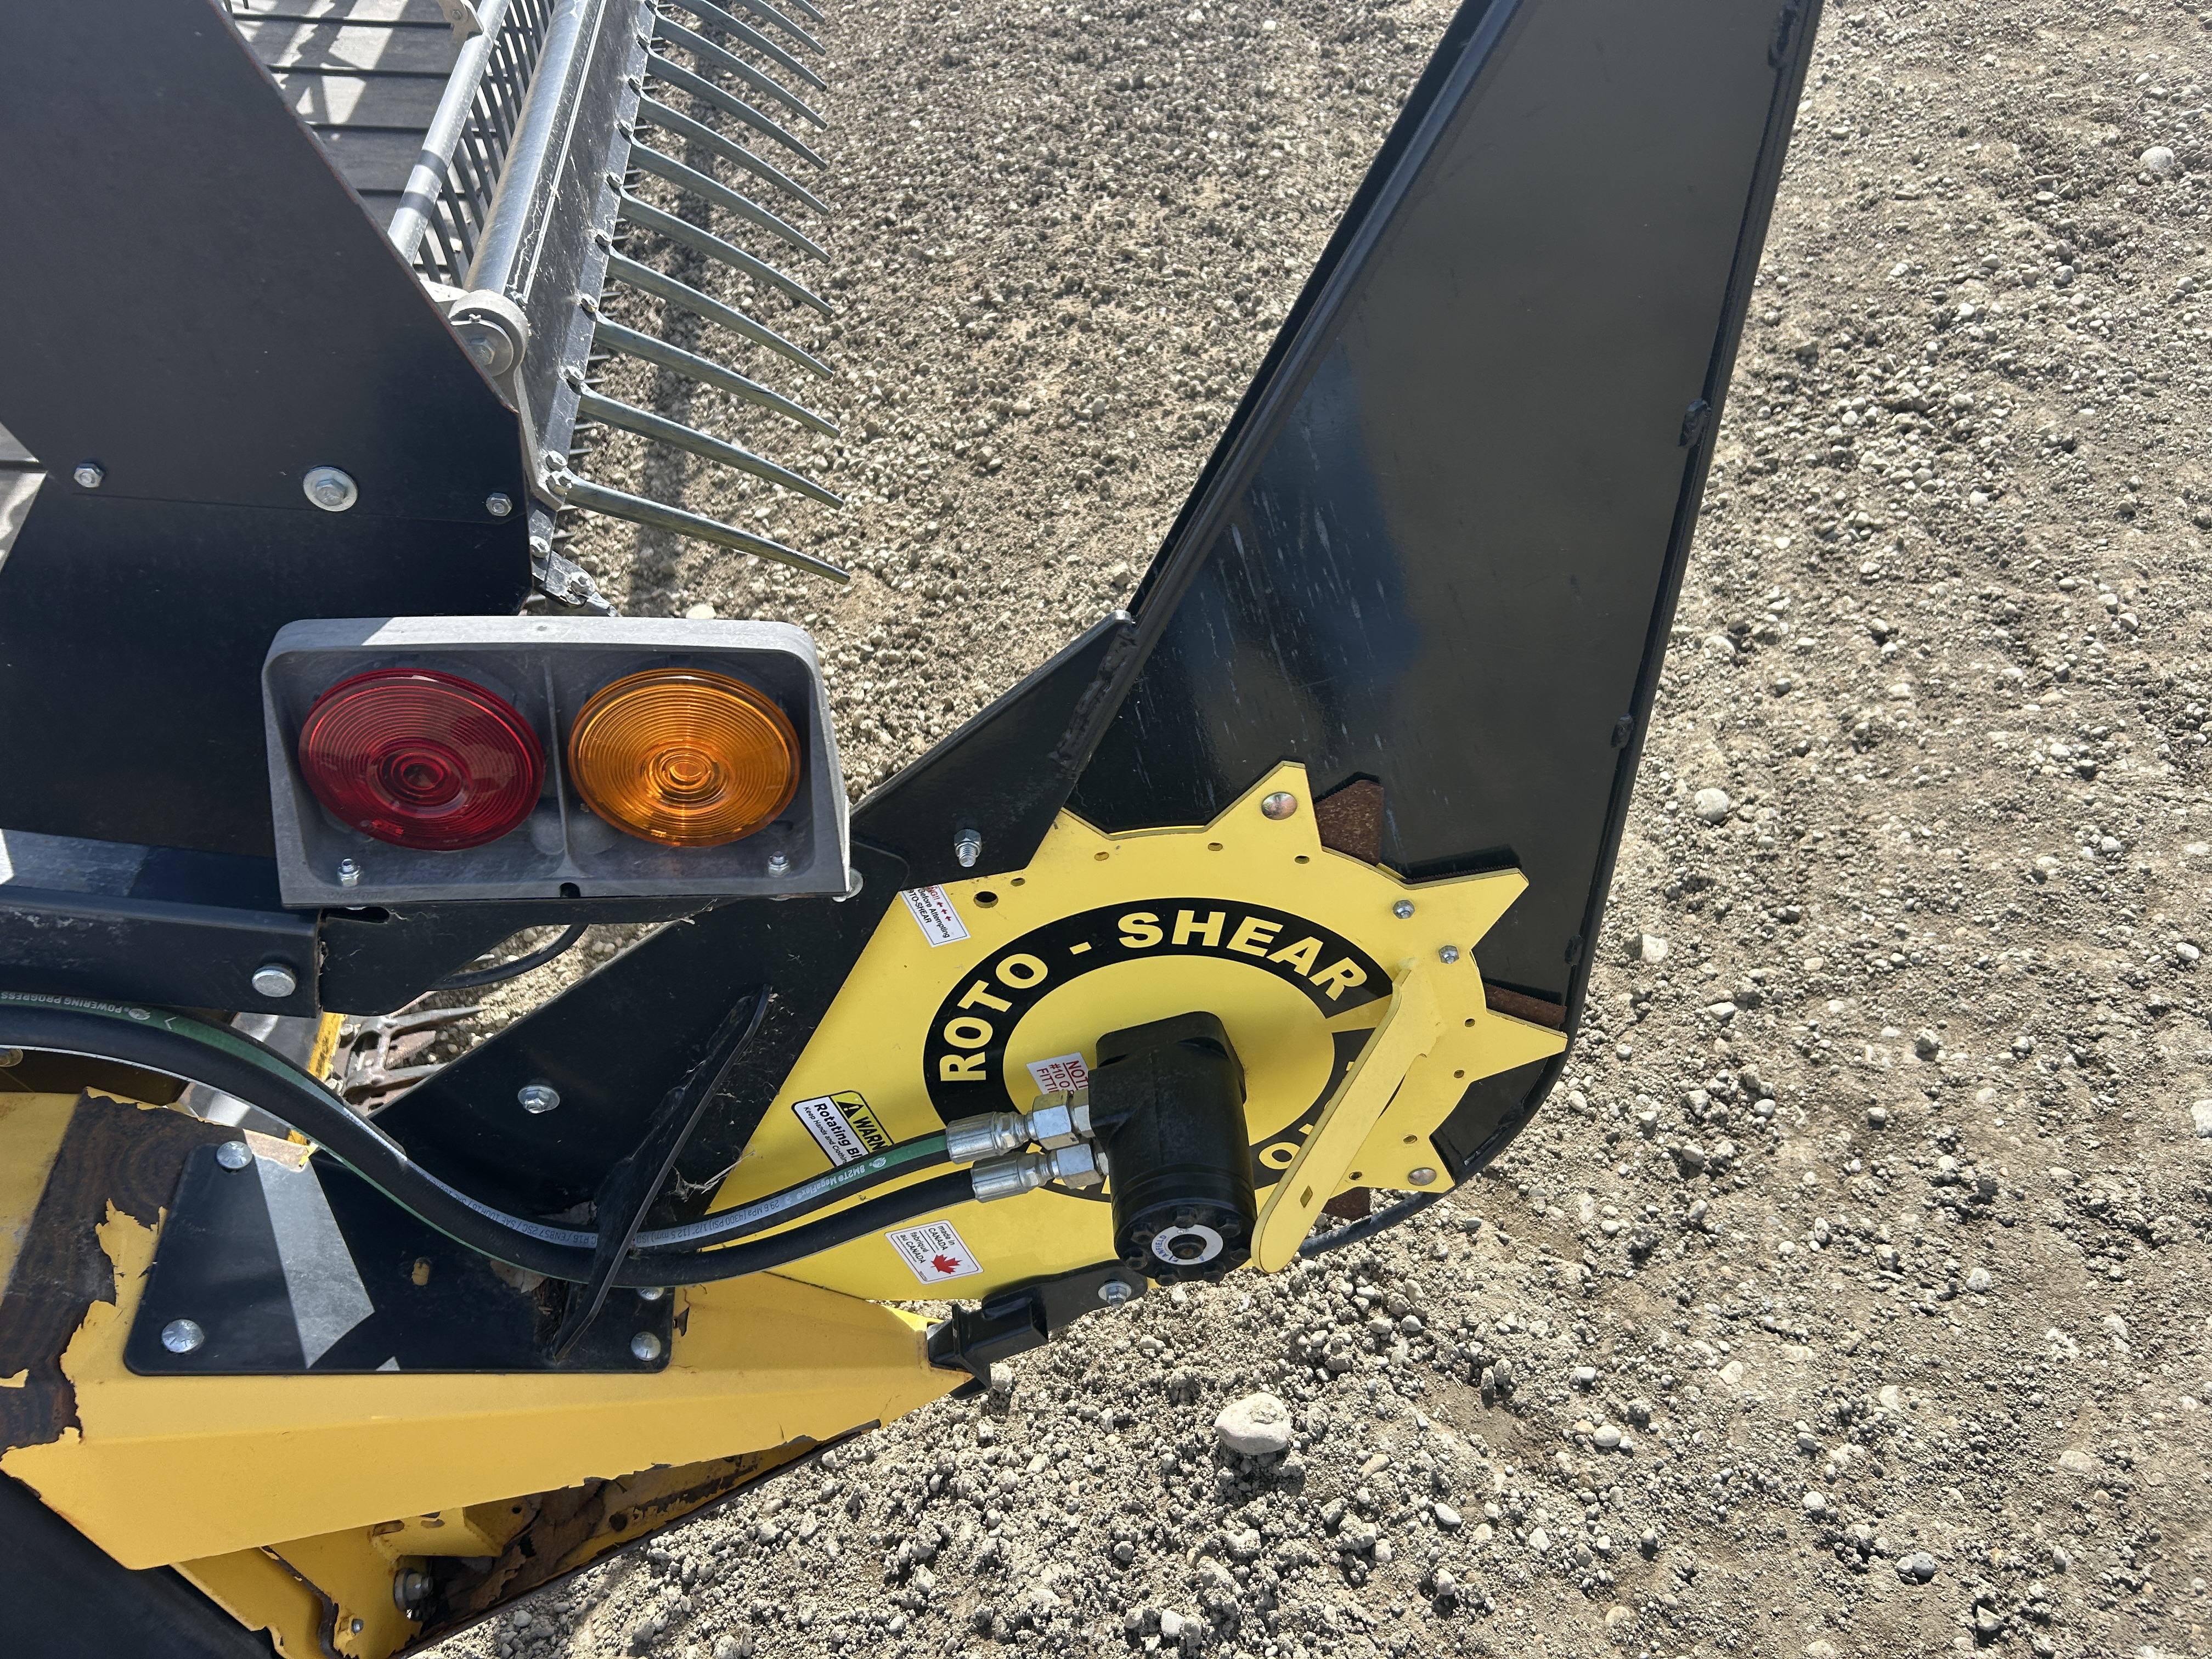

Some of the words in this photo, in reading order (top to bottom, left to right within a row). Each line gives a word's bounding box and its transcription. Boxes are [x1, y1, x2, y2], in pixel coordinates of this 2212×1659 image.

[929, 908, 951, 938] Attempting
[1, 991, 62, 1004] PROGRESS
[64, 997, 123, 1013] POWERING
[939, 952, 1048, 1082] ROTO
[1118, 909, 1368, 1002] SHEAR
[1036, 1068, 1059, 1093] FITTI
[1048, 1063, 1065, 1079] #10
[1065, 1060, 1088, 1088] NOTI
[803, 1106, 816, 1120] Keep
[813, 1119, 828, 1135] Hands
[825, 1134, 836, 1146] and
[814, 1103, 852, 1146] Rotating
[853, 1115, 888, 1151] WARN
[748, 1207, 763, 1216] MPa
[910, 1232, 930, 1252] fabriqué
[928, 1227, 949, 1251] CANADA
[938, 1226, 951, 1240] made
[906, 1241, 927, 1264] CANADA
